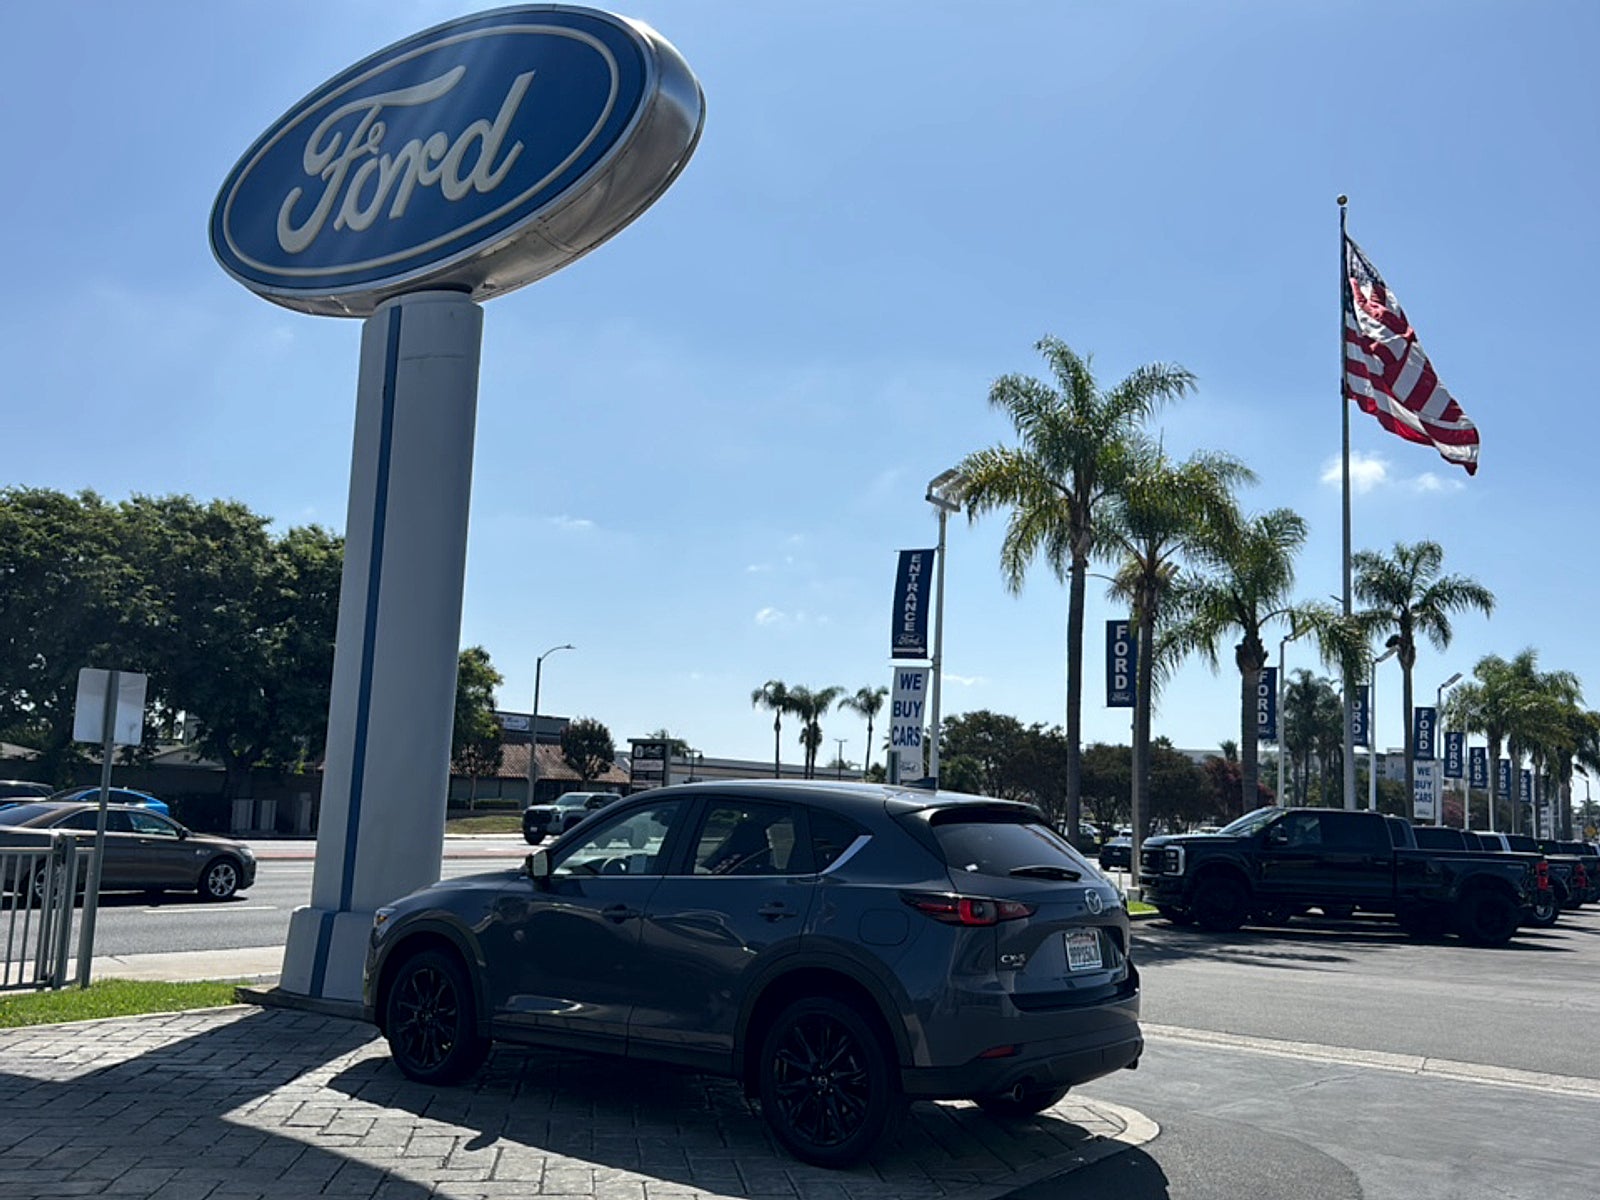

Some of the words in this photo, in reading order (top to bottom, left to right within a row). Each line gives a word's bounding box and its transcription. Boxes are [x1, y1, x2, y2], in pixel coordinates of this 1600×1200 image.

[276, 65, 537, 254] Ford
[904, 553, 922, 632] ENTRANCE
[1114, 624, 1128, 690] FORD
[900, 673, 922, 690] WE
[893, 701, 922, 718] BUY
[1257, 671, 1269, 725] FORD
[892, 726, 921, 747] CARS
[1419, 709, 1430, 750] FORD
[1449, 733, 1459, 769] FORD
[1473, 748, 1483, 780] FORD
[1414, 780, 1433, 790] BUY
[1417, 767, 1431, 777] WE
[1414, 791, 1433, 802] CARS
